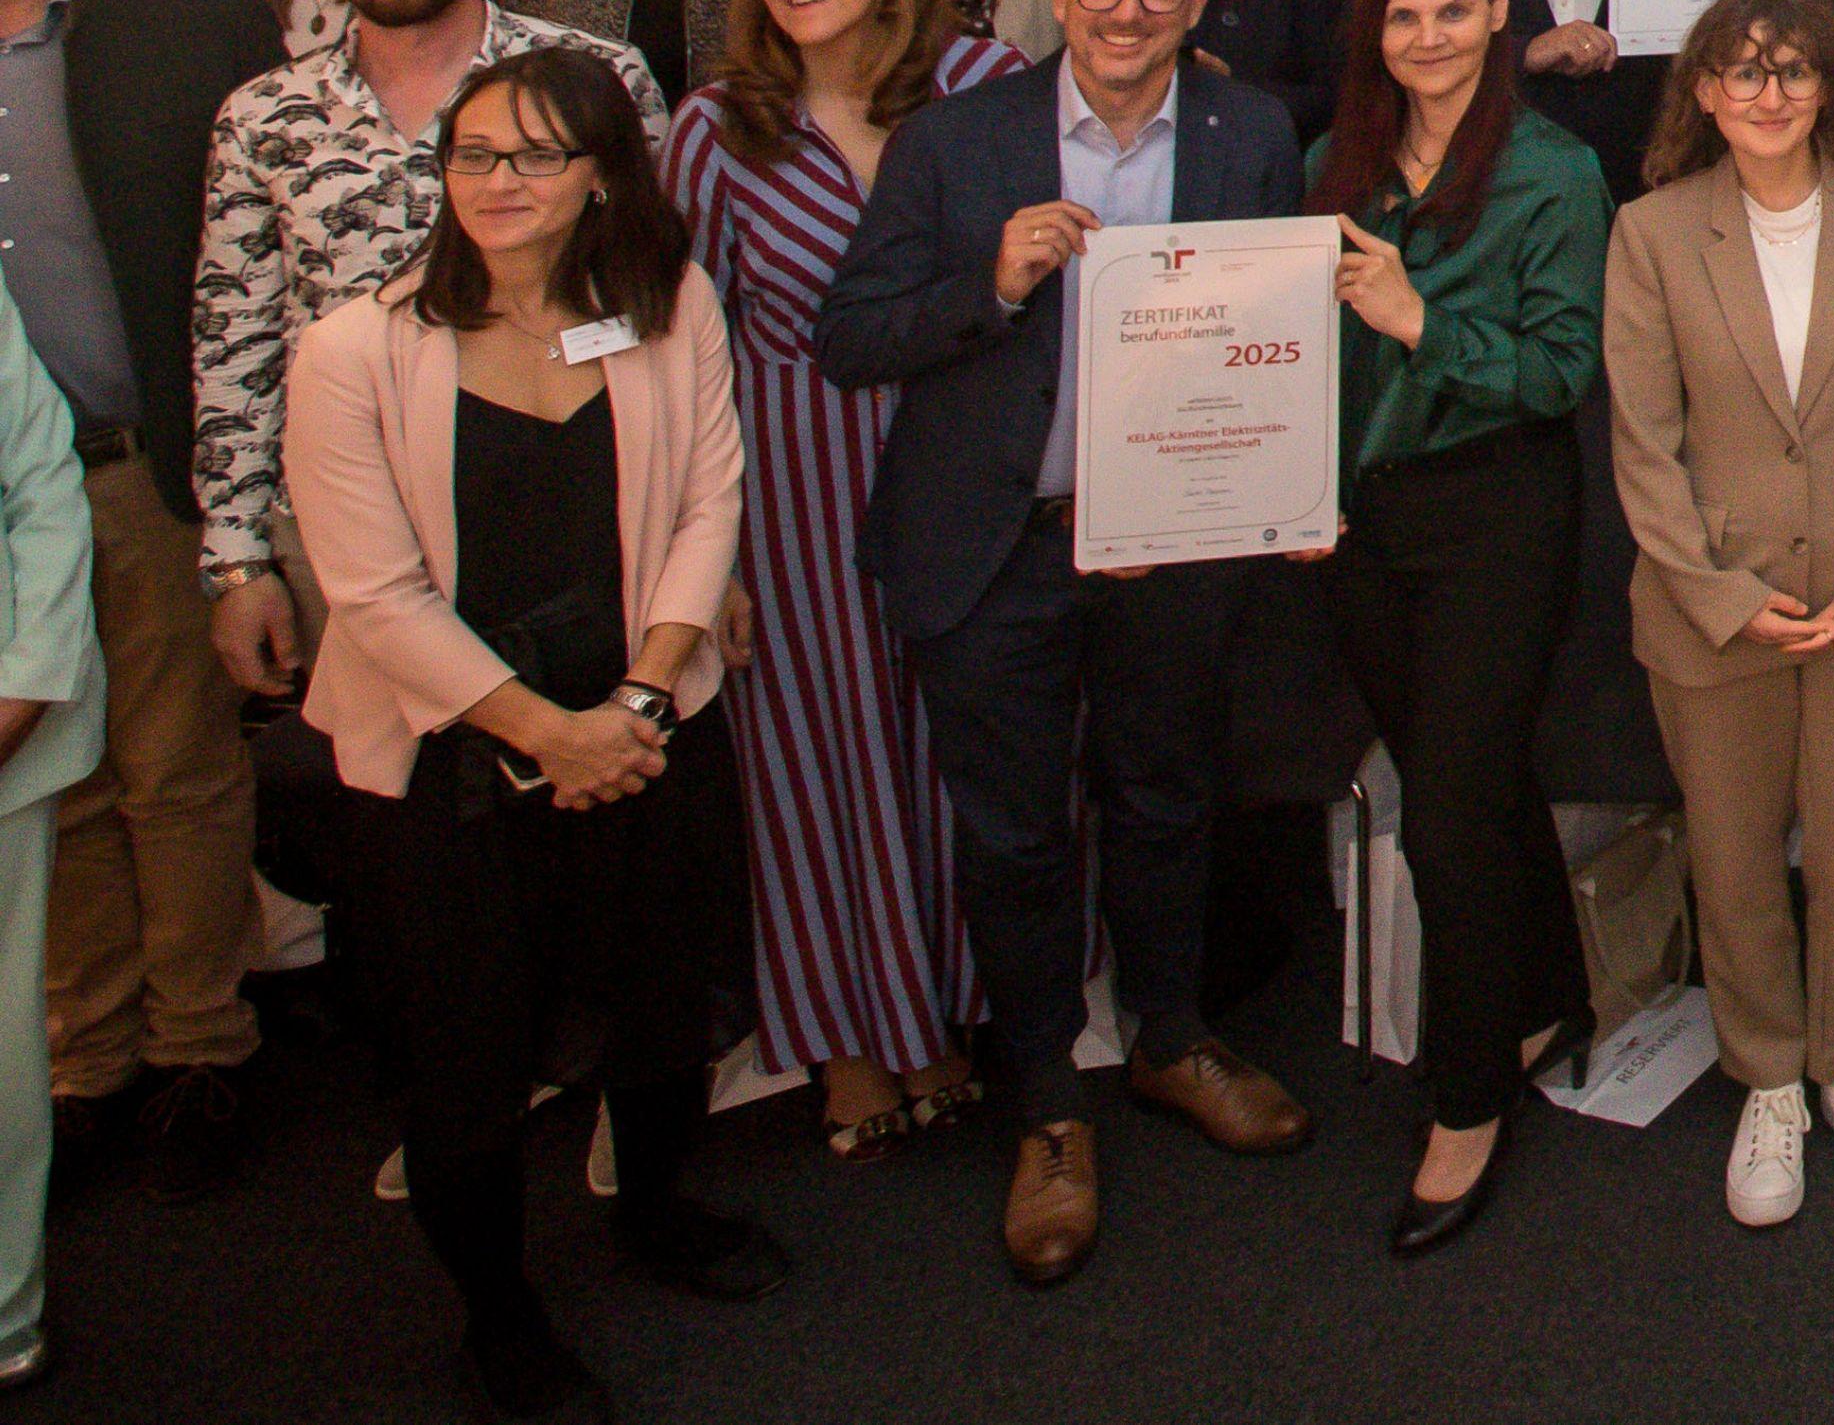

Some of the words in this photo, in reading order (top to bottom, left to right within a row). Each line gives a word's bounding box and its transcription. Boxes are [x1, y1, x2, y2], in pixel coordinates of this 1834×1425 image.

[1121, 304, 1228, 326] ZERTIFIKAT
[1121, 325, 1236, 343] berufundfamilie
[1225, 341, 1301, 367] 2025
